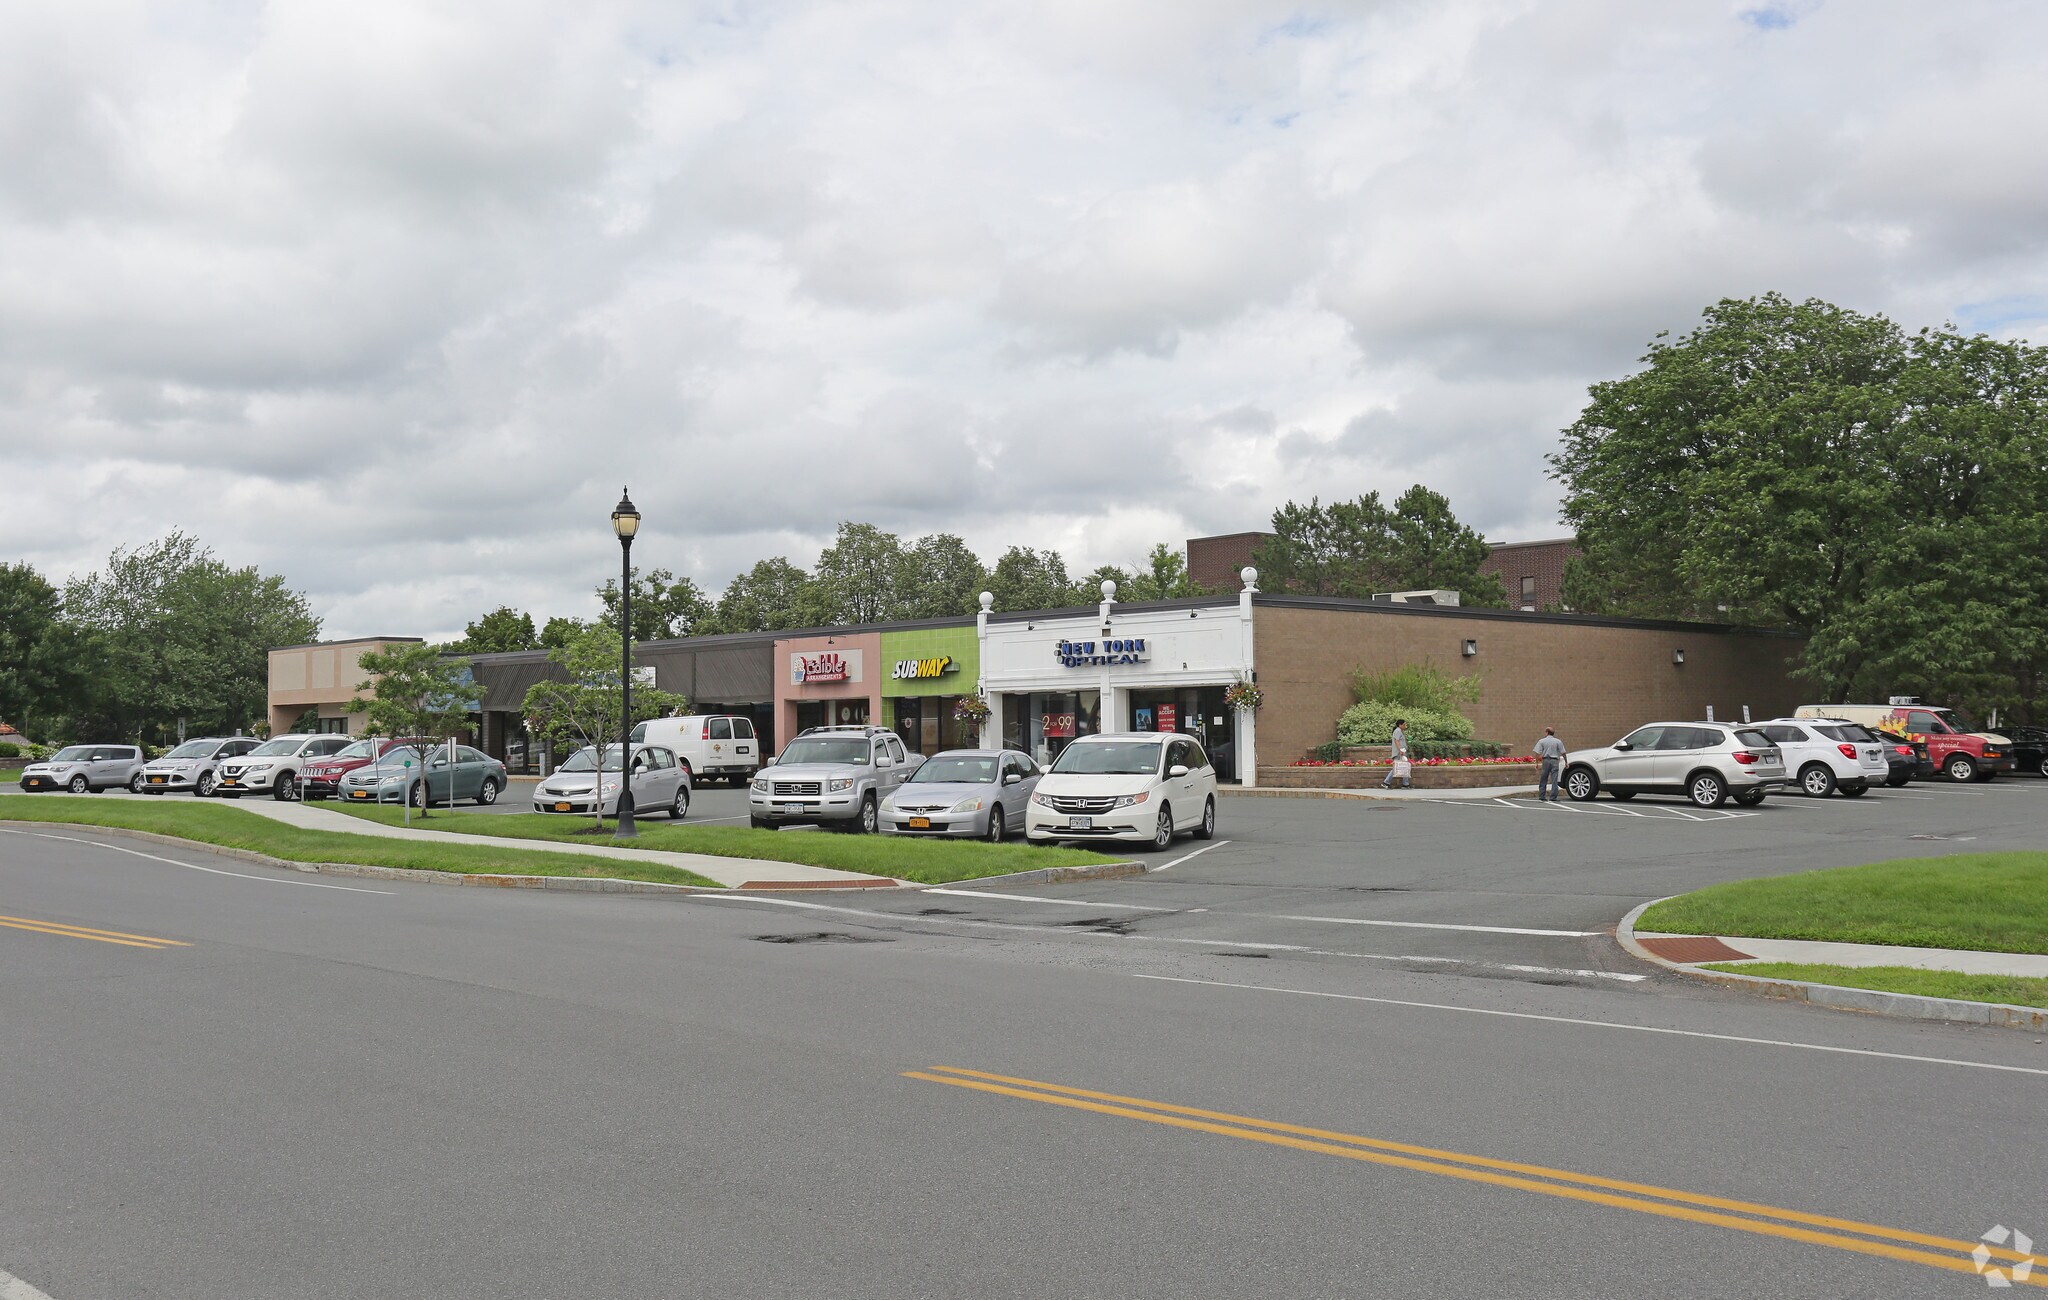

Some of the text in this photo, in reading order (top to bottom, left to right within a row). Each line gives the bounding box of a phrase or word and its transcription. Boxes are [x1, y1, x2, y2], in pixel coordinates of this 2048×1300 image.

[1062, 639, 1145, 655] NEW YORK
[806, 653, 846, 675] Edible
[892, 656, 950, 680] SUBWAY
[1064, 654, 1146, 668] OPTICAL
[806, 674, 843, 682] ARRANGEMENTS
[1042, 715, 1050, 730] 2
